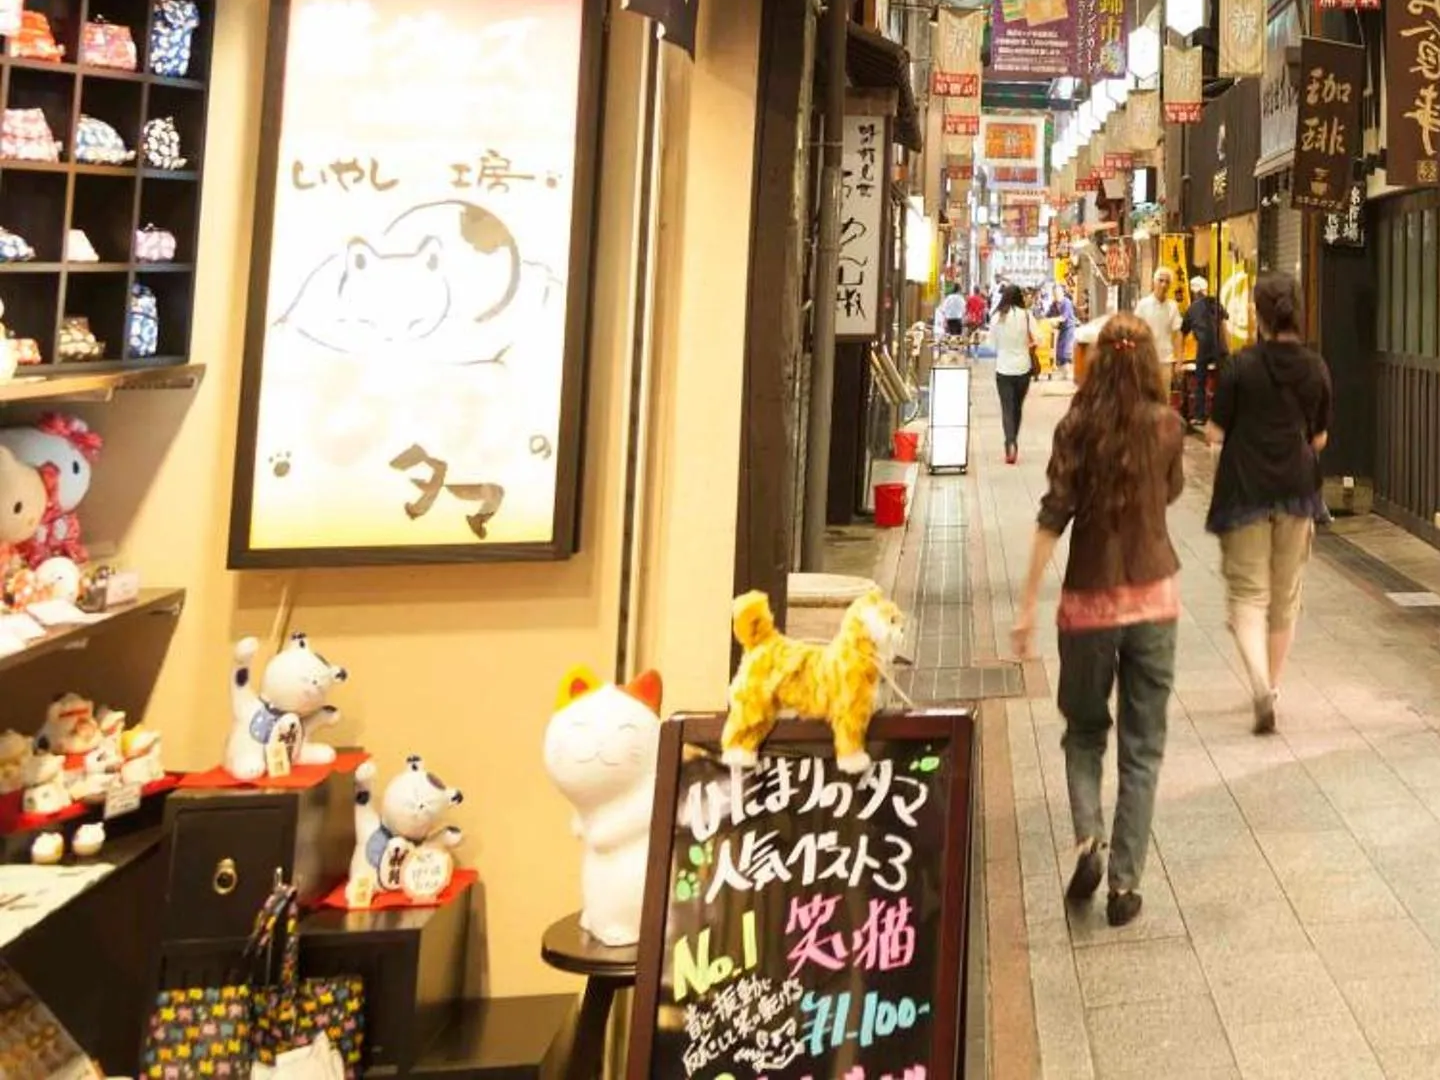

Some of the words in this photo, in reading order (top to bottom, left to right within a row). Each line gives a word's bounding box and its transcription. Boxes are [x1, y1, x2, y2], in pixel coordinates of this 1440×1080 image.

[1301, 67, 1352, 156] 珈琲
[292, 157, 399, 192] いやし
[389, 443, 505, 541] タマ
[687, 756, 929, 843] ひだまりのタマ
[705, 830, 913, 905] 人気ベスト3
[673, 910, 759, 1002] No.1
